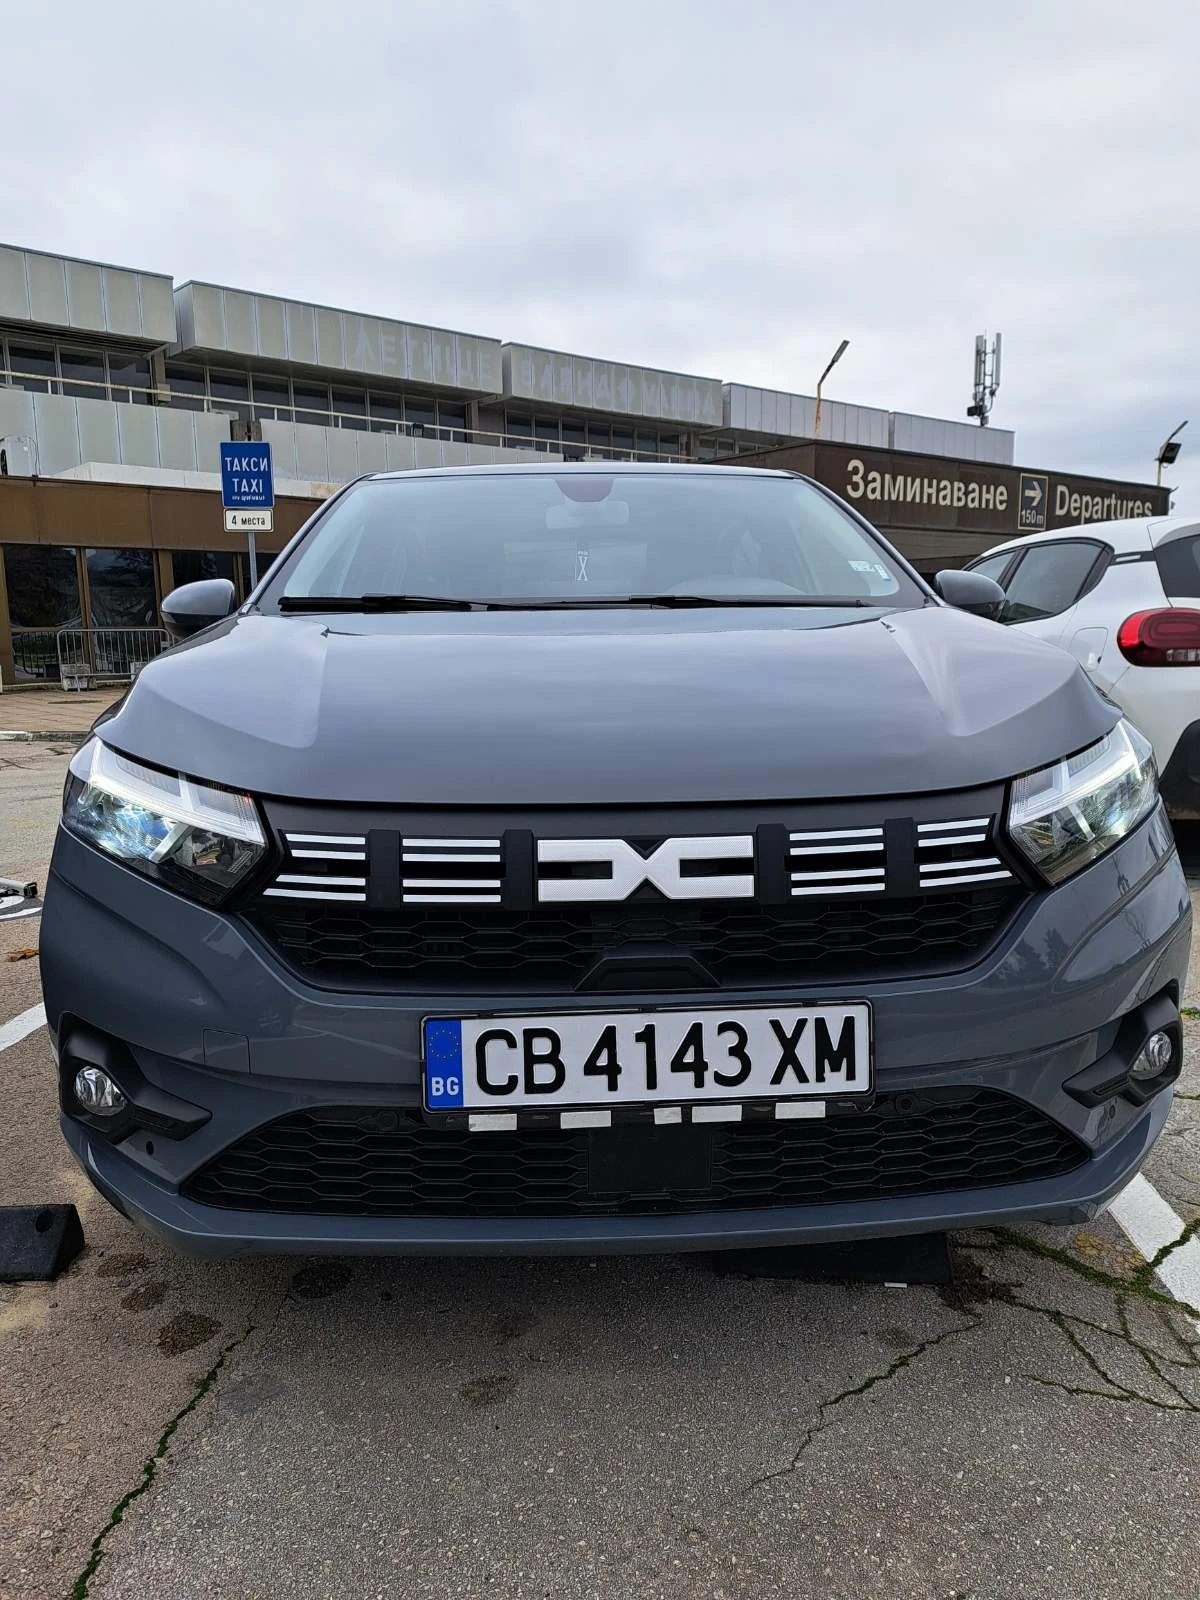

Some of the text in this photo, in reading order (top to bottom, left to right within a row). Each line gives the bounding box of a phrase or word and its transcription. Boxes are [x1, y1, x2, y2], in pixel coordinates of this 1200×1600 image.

[225, 457, 268, 471] ТАКСИ
[232, 478, 263, 493] TAXI
[846, 459, 1008, 511] Заминаване
[1055, 484, 1153, 524] Departures
[231, 515, 265, 526] 4 места
[475, 1015, 856, 1096] CB 4143 XM
[431, 1076, 459, 1096] BG
